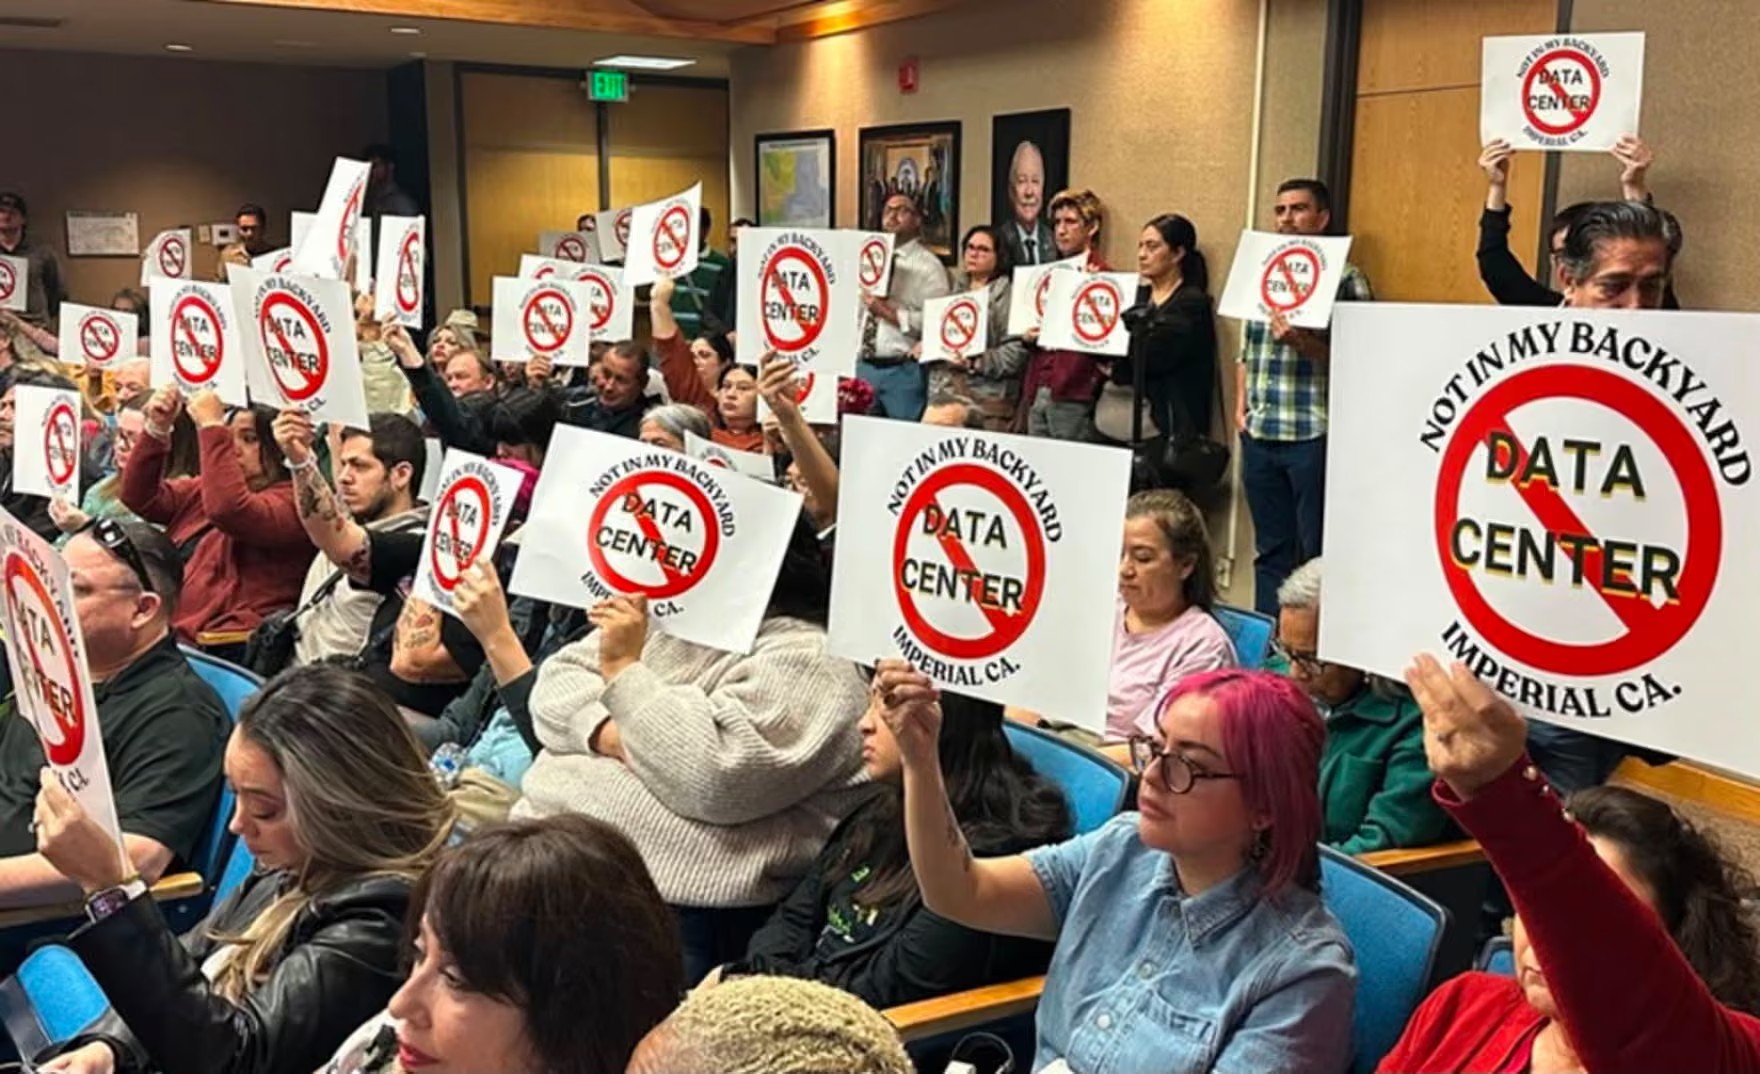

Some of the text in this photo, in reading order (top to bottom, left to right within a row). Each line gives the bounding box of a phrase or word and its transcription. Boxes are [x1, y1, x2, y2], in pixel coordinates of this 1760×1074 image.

[1528, 94, 1590, 111] CENTER
[1538, 67, 1583, 85] DATA
[1420, 321, 1751, 487] NOT IN MY BACKYARD
[589, 465, 620, 498] NOT
[619, 455, 643, 473] IN
[645, 454, 672, 469] MY
[673, 457, 736, 538] BACKYARD
[887, 436, 1062, 543] NOT IN MY BACKYARD
[1485, 430, 1647, 502] DATA
[621, 491, 695, 534] DATA
[922, 502, 1008, 550] DATA
[595, 525, 698, 574] CENTER
[1450, 517, 1681, 606] CENTER
[901, 558, 1024, 613] CENTER
[893, 625, 1020, 687] IMPERIAL CA.
[1441, 621, 1682, 718] IMPERIAL CA.
